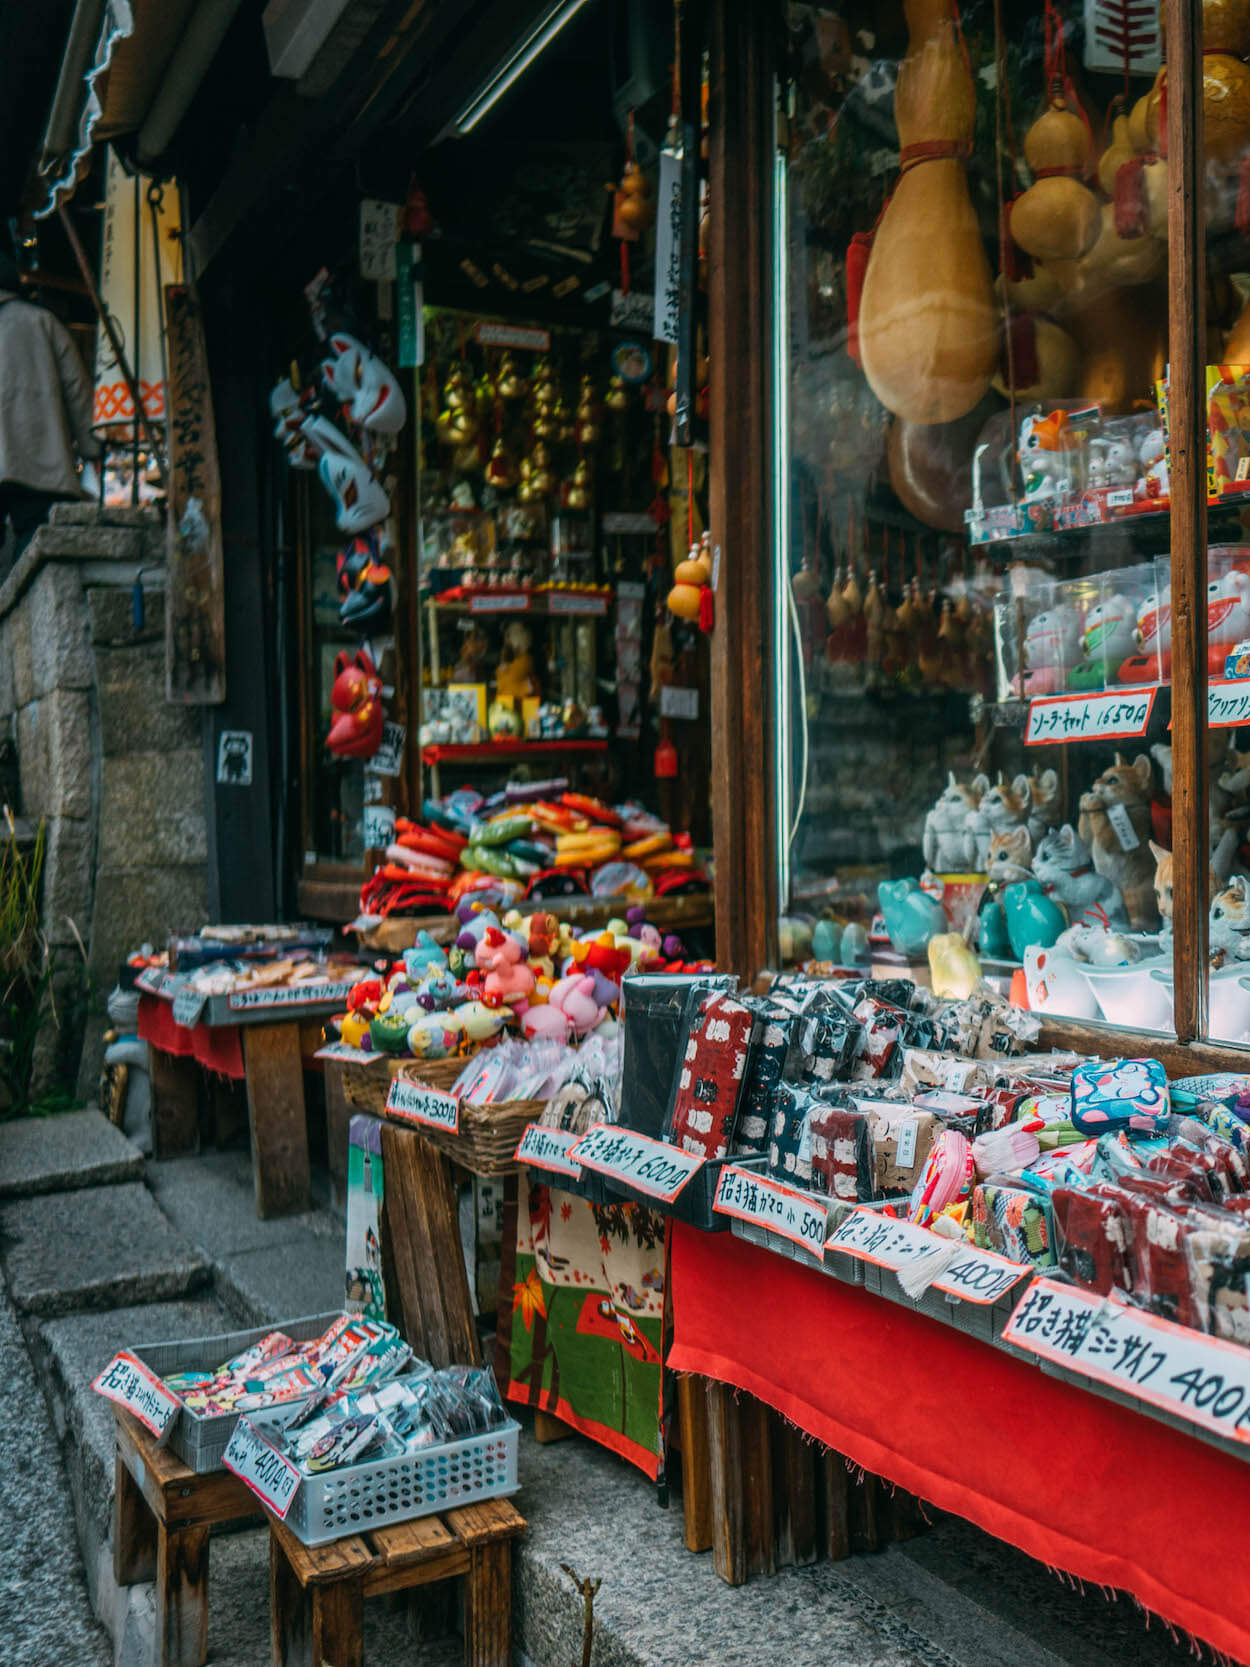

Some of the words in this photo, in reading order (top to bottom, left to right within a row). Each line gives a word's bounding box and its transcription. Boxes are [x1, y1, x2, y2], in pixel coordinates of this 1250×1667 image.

[1097, 703, 1147, 726] 1650円
[637, 1156, 690, 1191] 600円
[800, 1211, 824, 1244] 500
[946, 1259, 1021, 1300] 400円
[1015, 1290, 1167, 1384] 招き猫ミニサイフ
